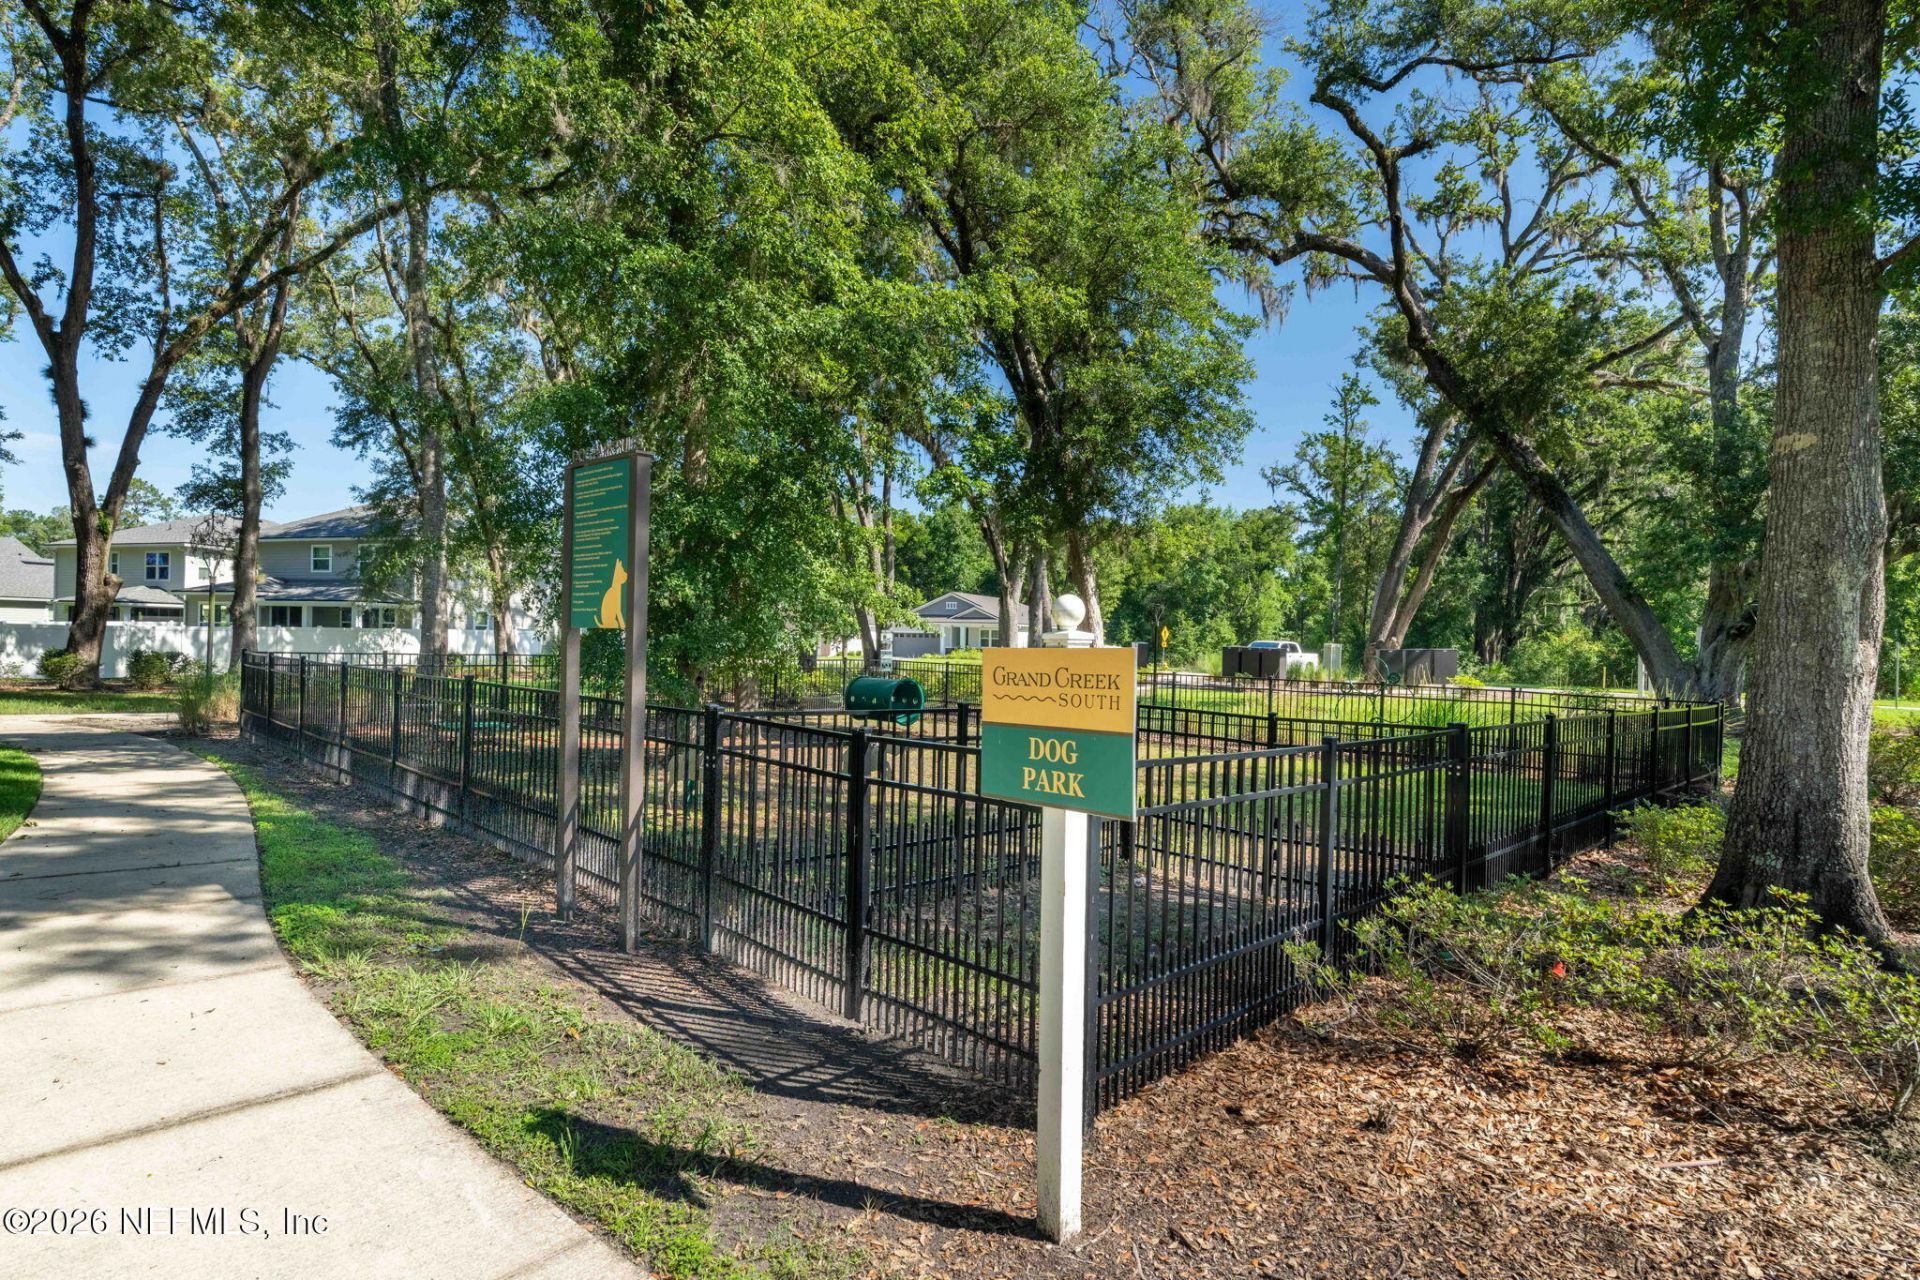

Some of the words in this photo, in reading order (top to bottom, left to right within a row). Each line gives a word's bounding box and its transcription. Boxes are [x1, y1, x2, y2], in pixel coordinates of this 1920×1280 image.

[993, 665, 1052, 687] GRAND
[1055, 666, 1121, 690] CREEK
[1058, 692, 1120, 711] SOUTH
[1028, 736, 1079, 765] DOG
[1022, 766, 1086, 798] PARK
